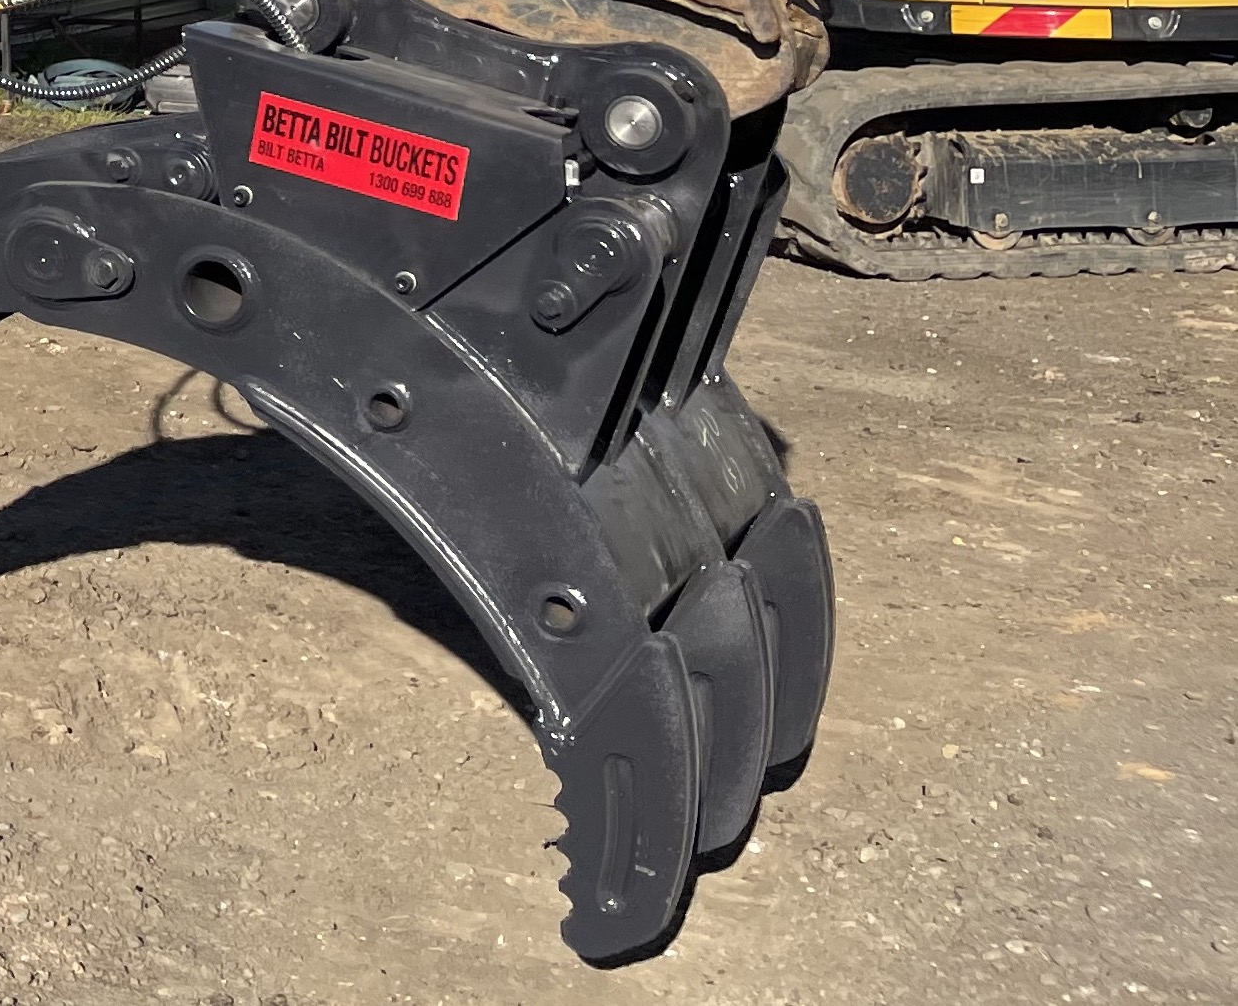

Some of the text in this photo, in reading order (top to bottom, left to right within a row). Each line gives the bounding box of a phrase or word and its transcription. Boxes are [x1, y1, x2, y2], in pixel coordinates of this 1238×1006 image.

[257, 139, 325, 172] BILT BETTA
[262, 104, 459, 185] BETTA BILT BUCKETS
[369, 171, 399, 193] 1300
[401, 181, 426, 201] 699
